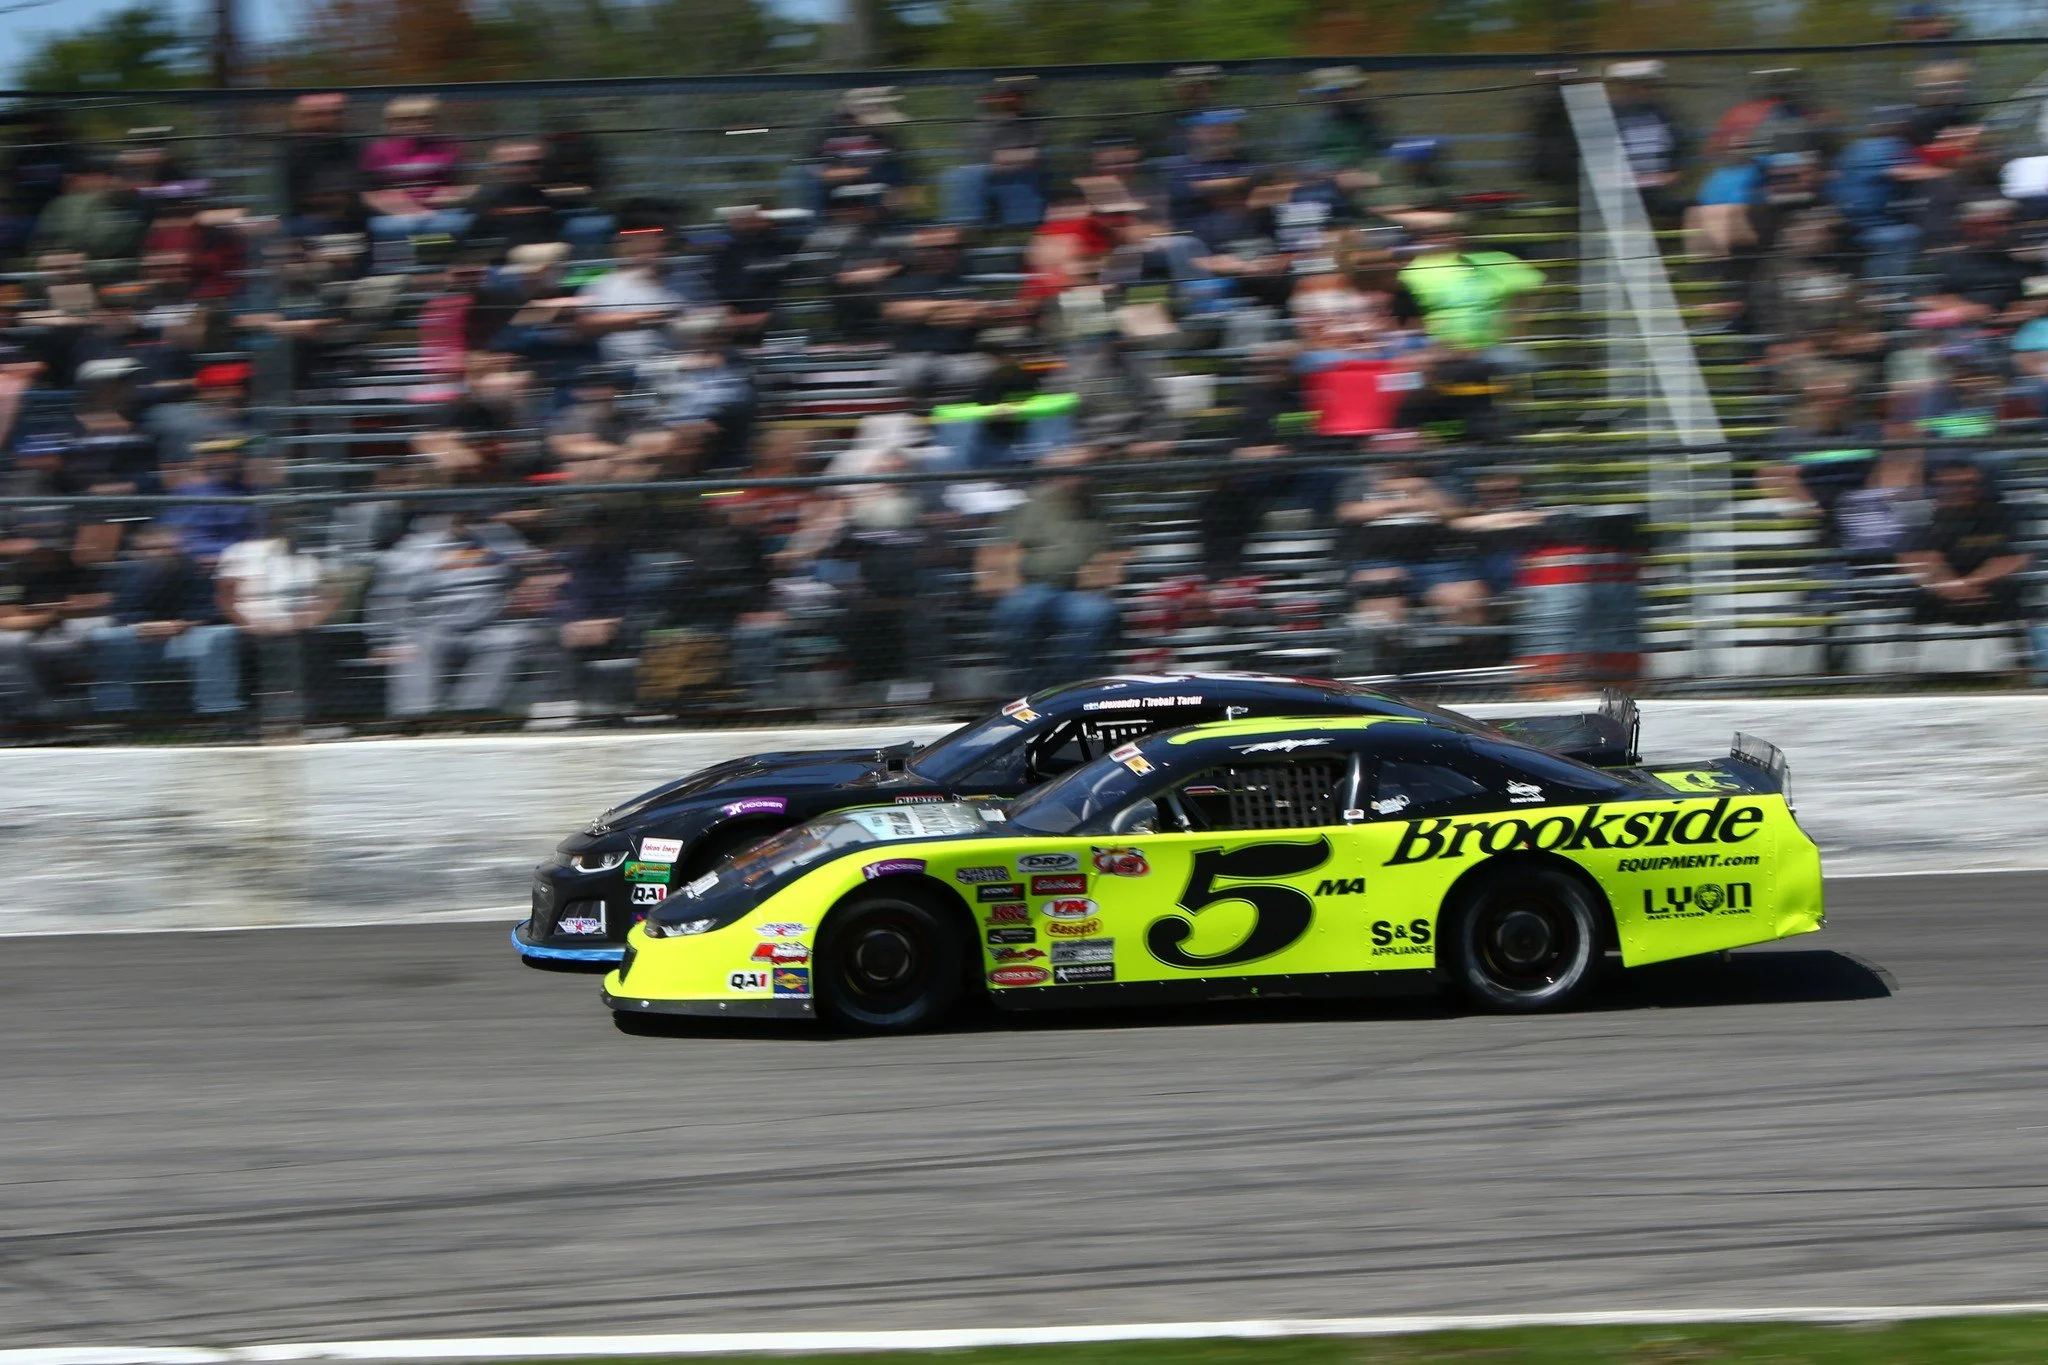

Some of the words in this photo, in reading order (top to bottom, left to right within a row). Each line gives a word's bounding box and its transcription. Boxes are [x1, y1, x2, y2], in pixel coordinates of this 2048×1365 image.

[742, 801, 783, 809] HOOSIER
[1382, 798, 1763, 866] Brookside
[1028, 856, 1070, 866] DRP
[1617, 854, 1759, 872] EQUIPMENT.com
[633, 887, 665, 902] QA1
[1143, 833, 1334, 970] 5
[1314, 878, 1366, 896] MA
[1371, 918, 1431, 946] S&S
[1371, 944, 1434, 956] APPLIANCE
[731, 973, 767, 989] QA1
